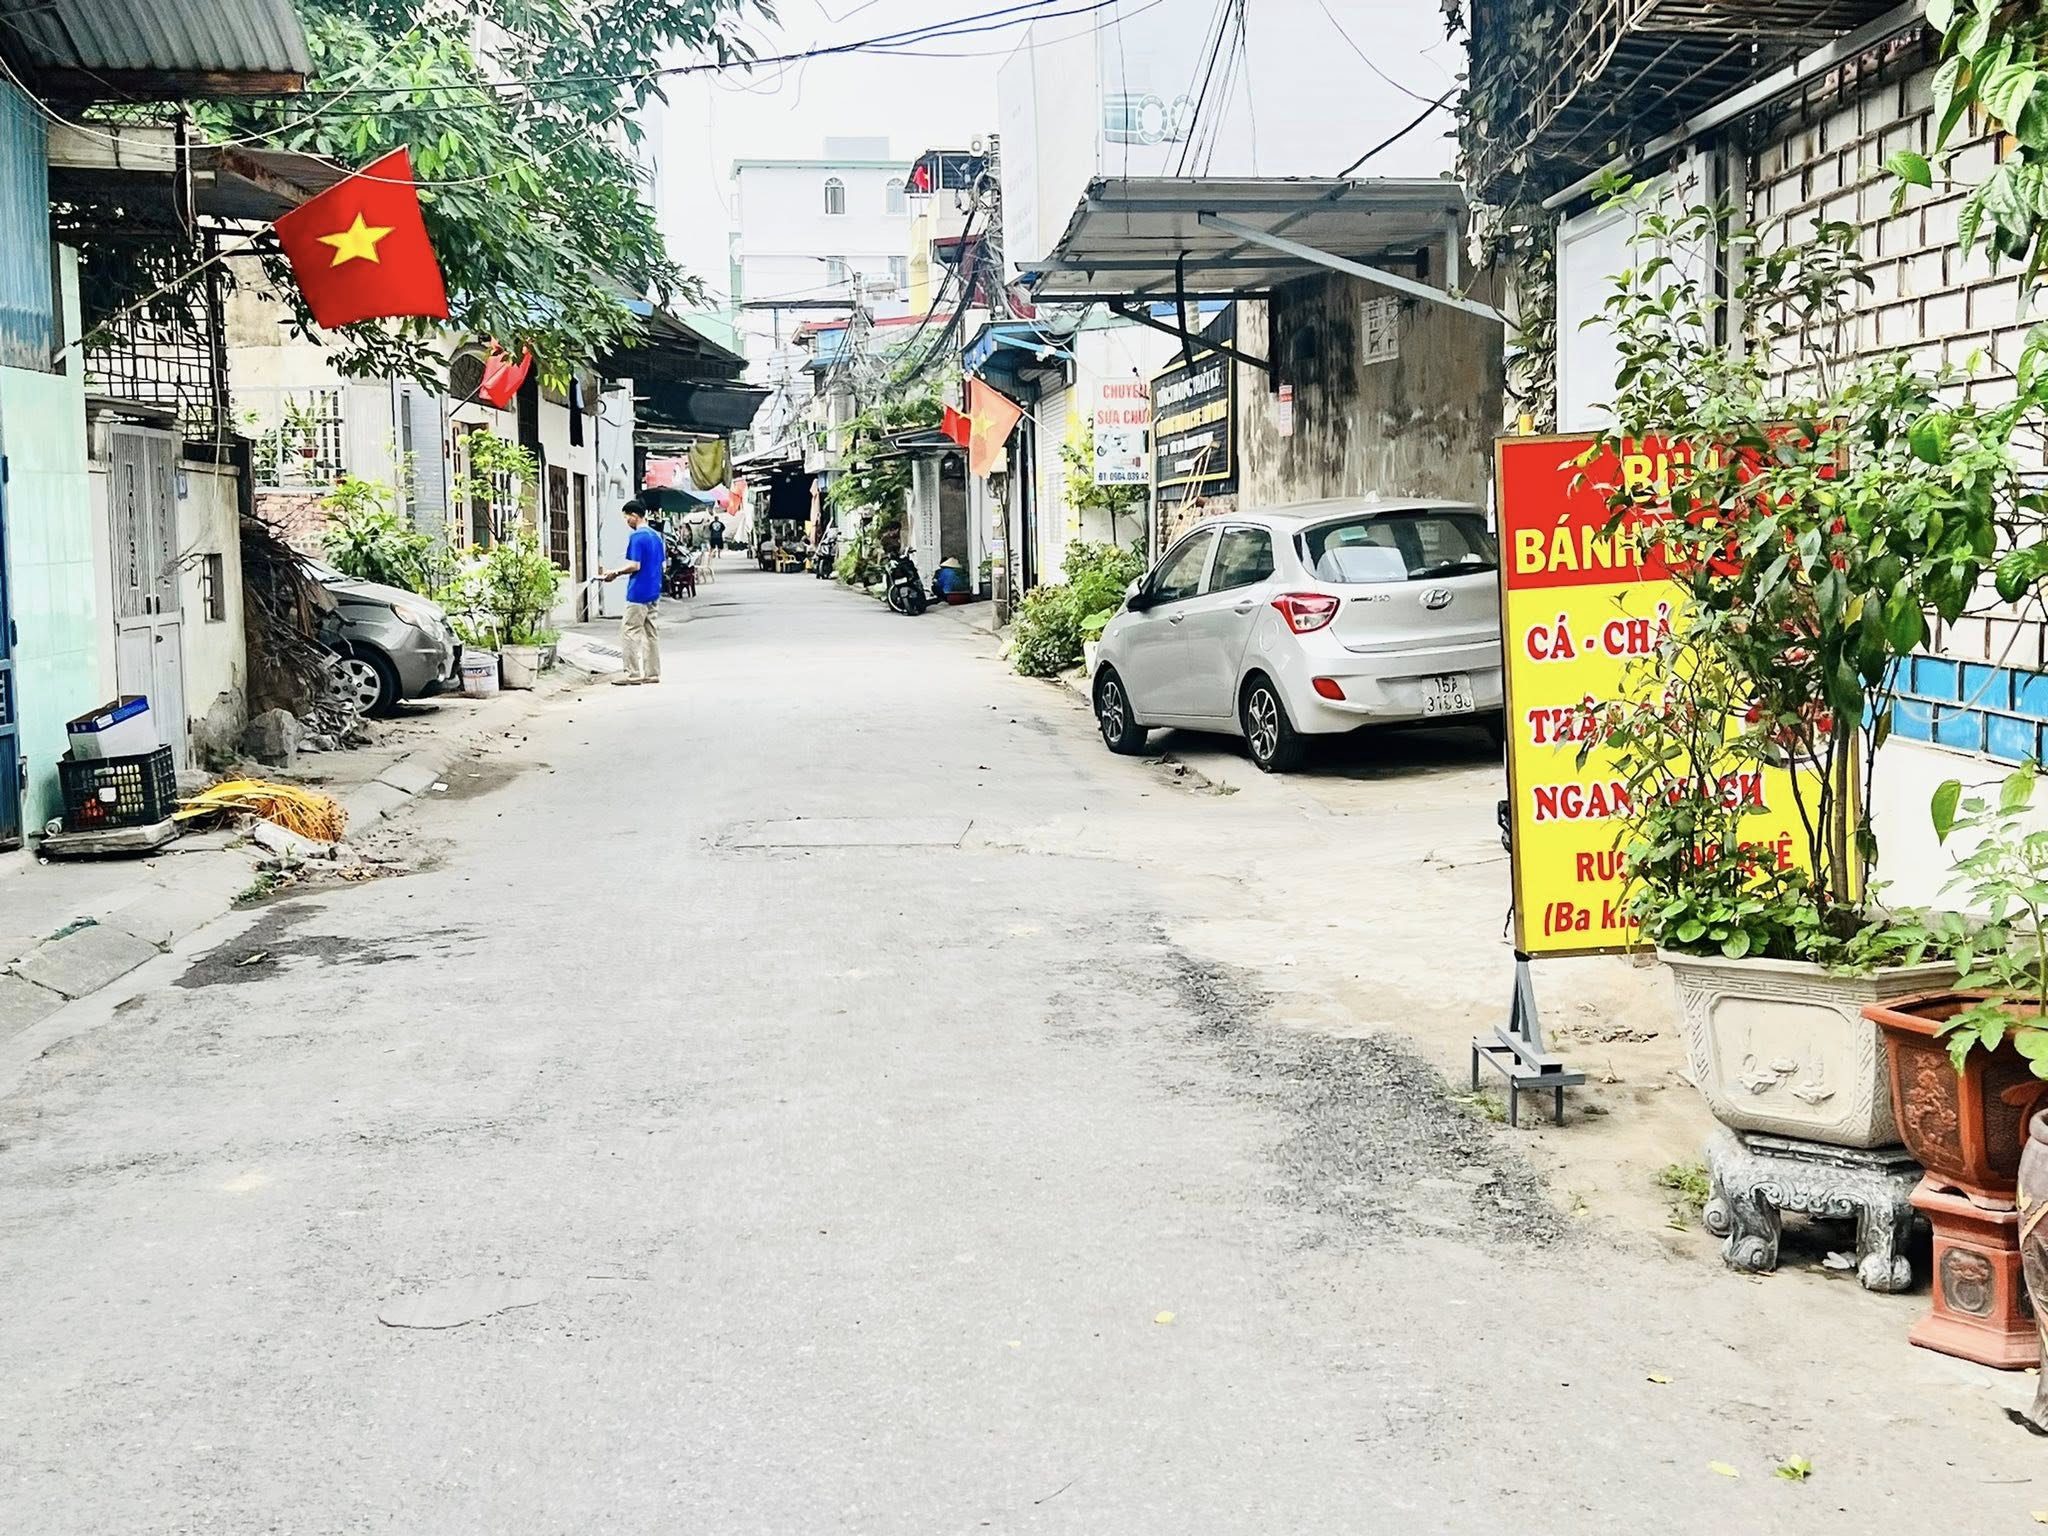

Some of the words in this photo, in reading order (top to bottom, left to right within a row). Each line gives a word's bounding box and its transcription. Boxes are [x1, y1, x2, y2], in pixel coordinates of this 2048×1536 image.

[1515, 514, 1645, 575] BÁNH
[1527, 614, 1575, 661] CÁ
[1534, 782, 1636, 820] NGAN
[1544, 902, 1591, 936] (Ba
